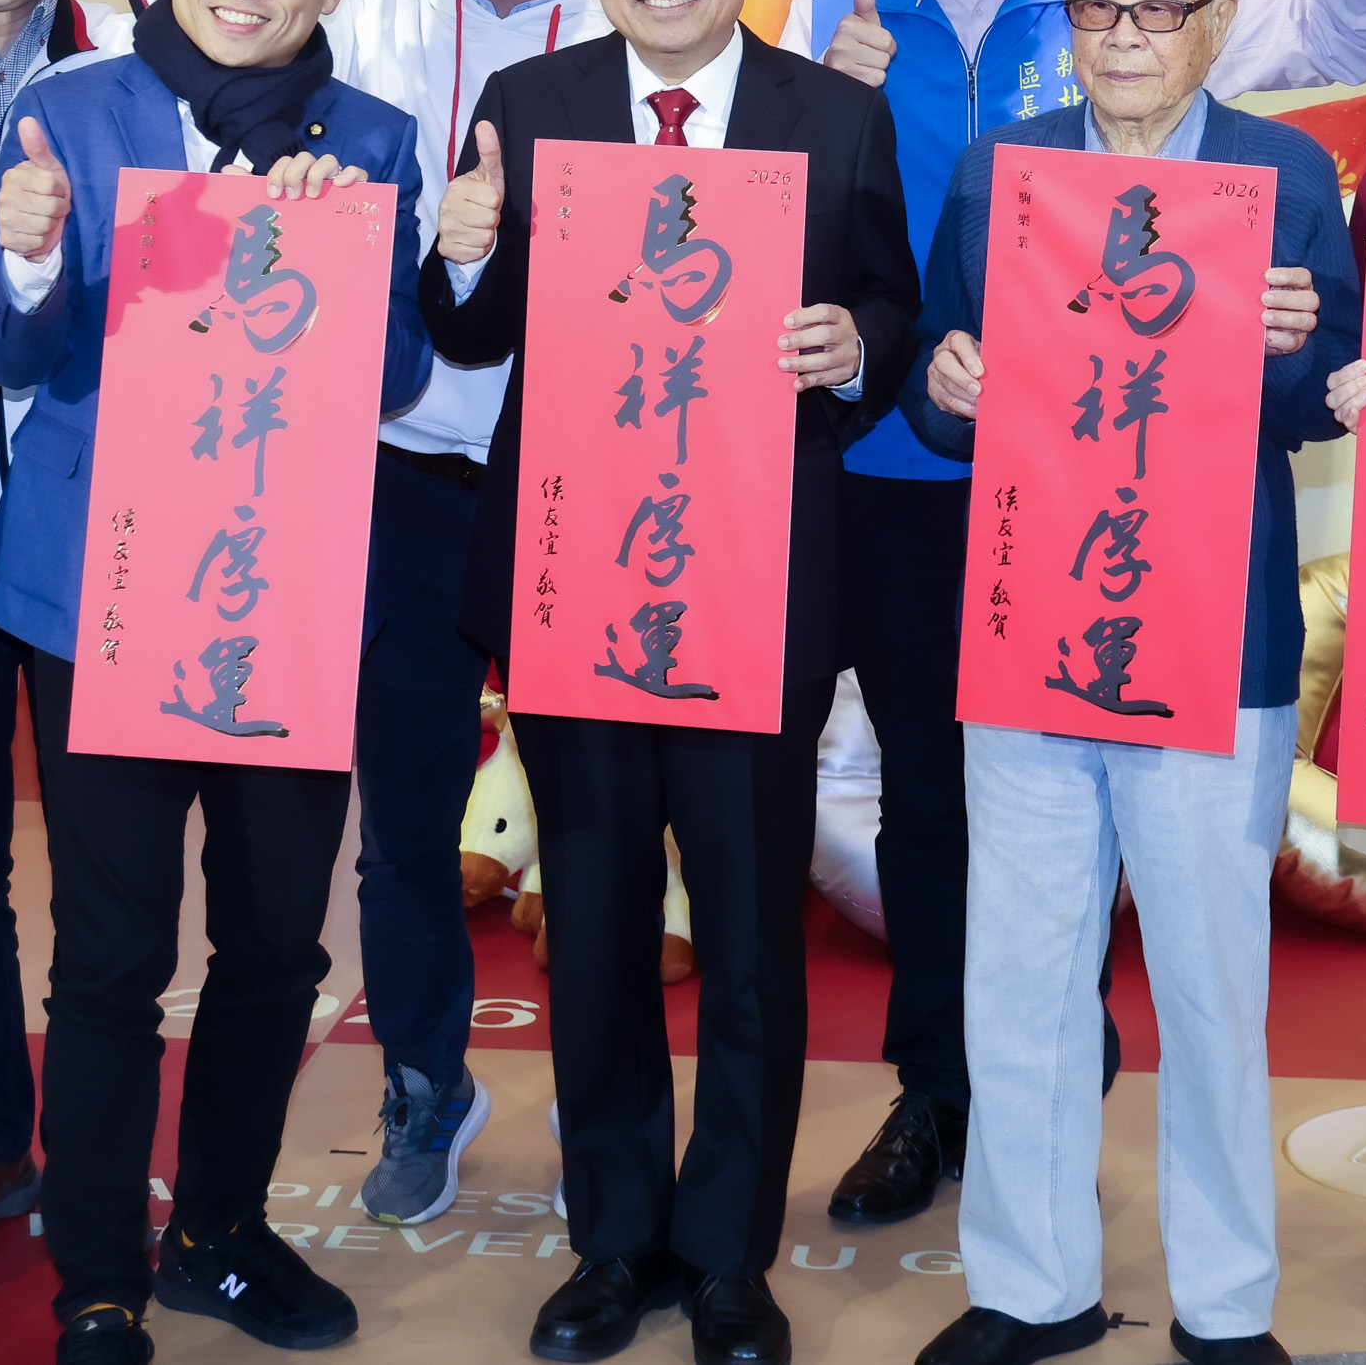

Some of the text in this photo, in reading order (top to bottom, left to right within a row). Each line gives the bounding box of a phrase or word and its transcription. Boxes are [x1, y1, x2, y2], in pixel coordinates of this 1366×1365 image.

[1054, 47, 1085, 110] 新北
[746, 169, 792, 186] 2026
[1211, 180, 1260, 200] 2026
[334, 200, 382, 216] 2026
